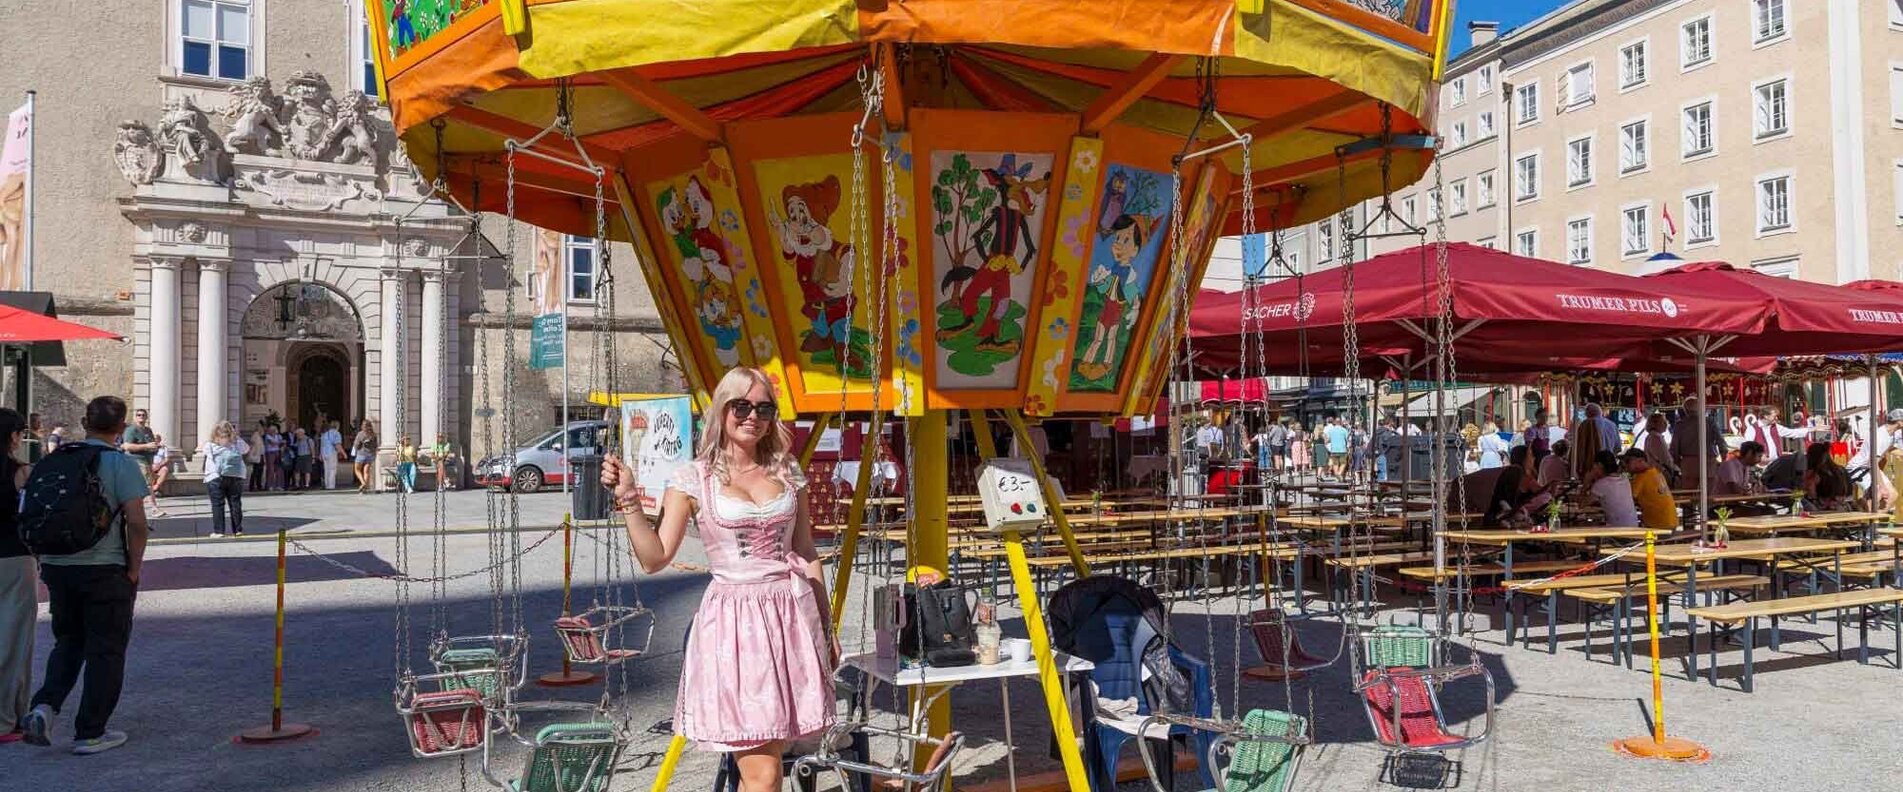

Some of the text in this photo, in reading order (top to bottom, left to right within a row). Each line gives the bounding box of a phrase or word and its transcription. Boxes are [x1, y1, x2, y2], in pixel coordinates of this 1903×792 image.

[1244, 304, 1291, 320] SACHER
[1555, 294, 1661, 313] TRUMER PILS
